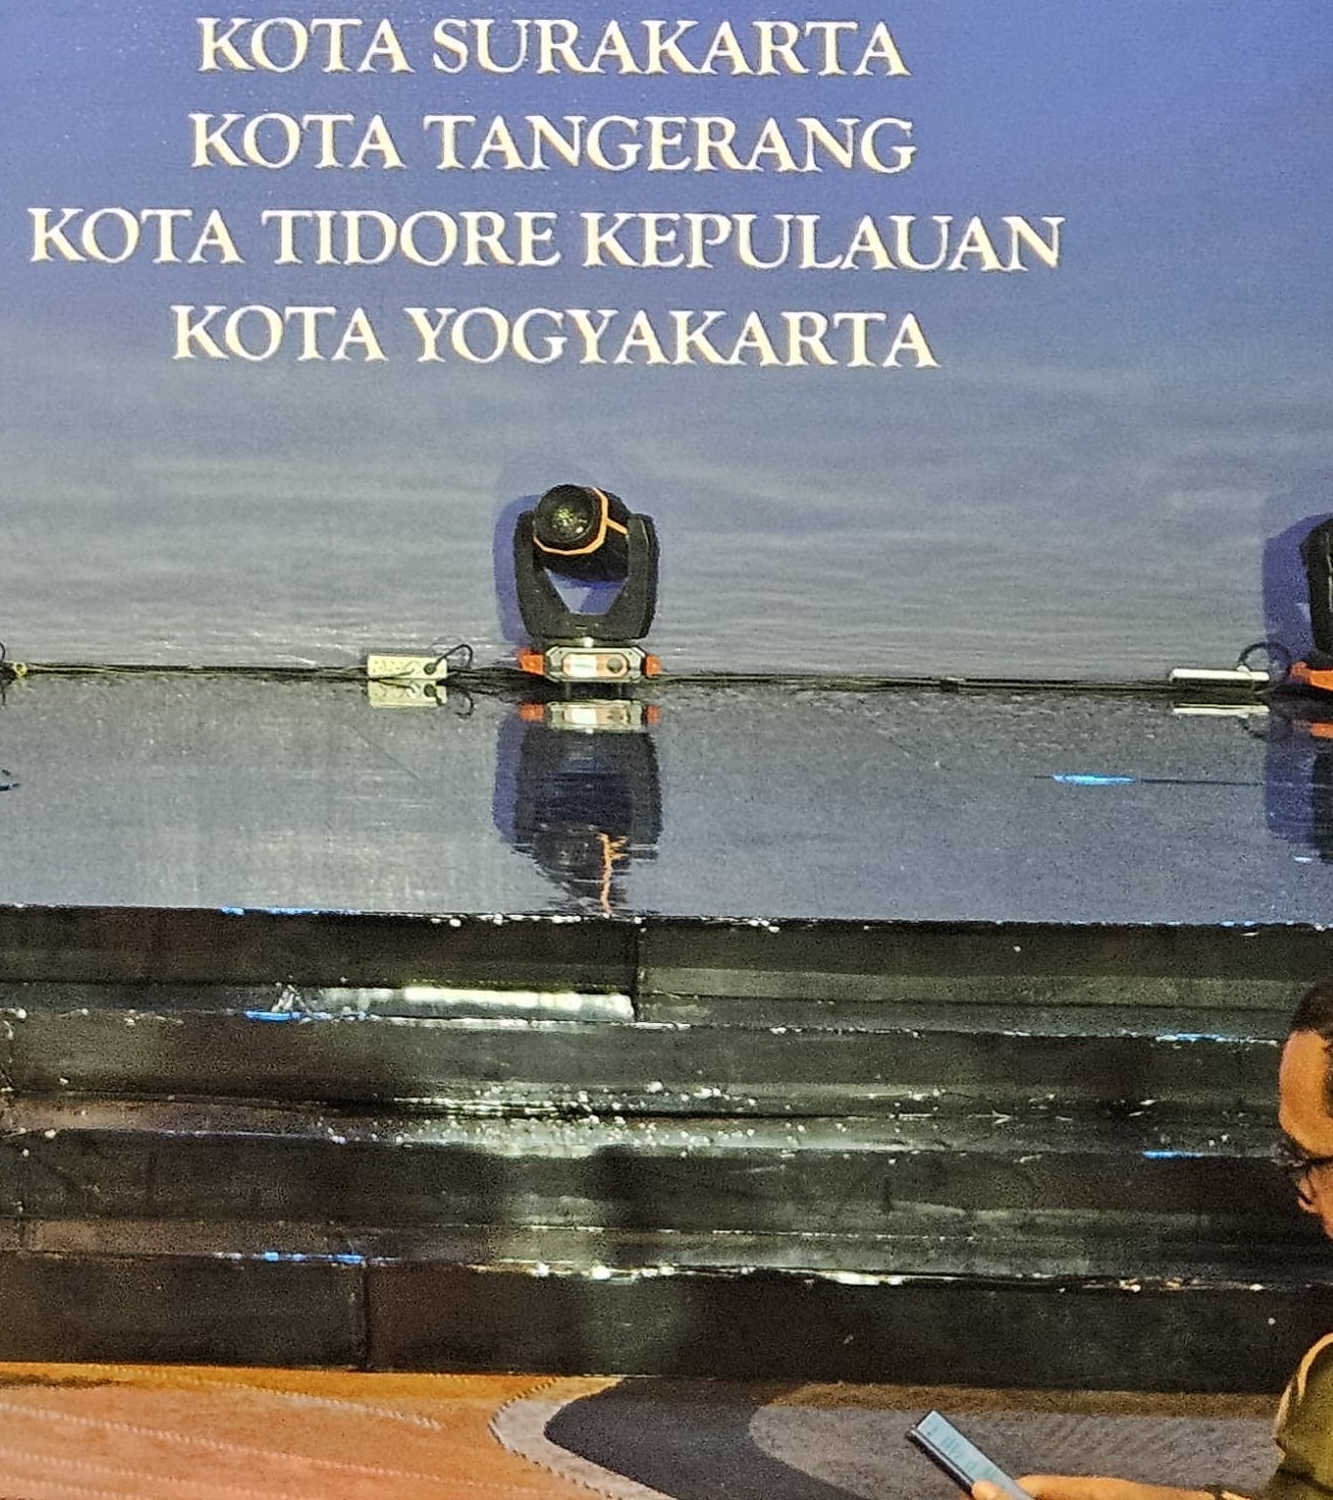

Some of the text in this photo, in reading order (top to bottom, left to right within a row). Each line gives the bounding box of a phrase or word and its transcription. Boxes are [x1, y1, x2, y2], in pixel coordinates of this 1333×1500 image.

[196, 17, 909, 77] KOTA SURAKARTA
[188, 112, 916, 175] KOTA TANGERANG
[27, 207, 1064, 272] KOTA TIDORE KEPULAUAN
[171, 305, 939, 369] KOTA YOGYAKARTA
